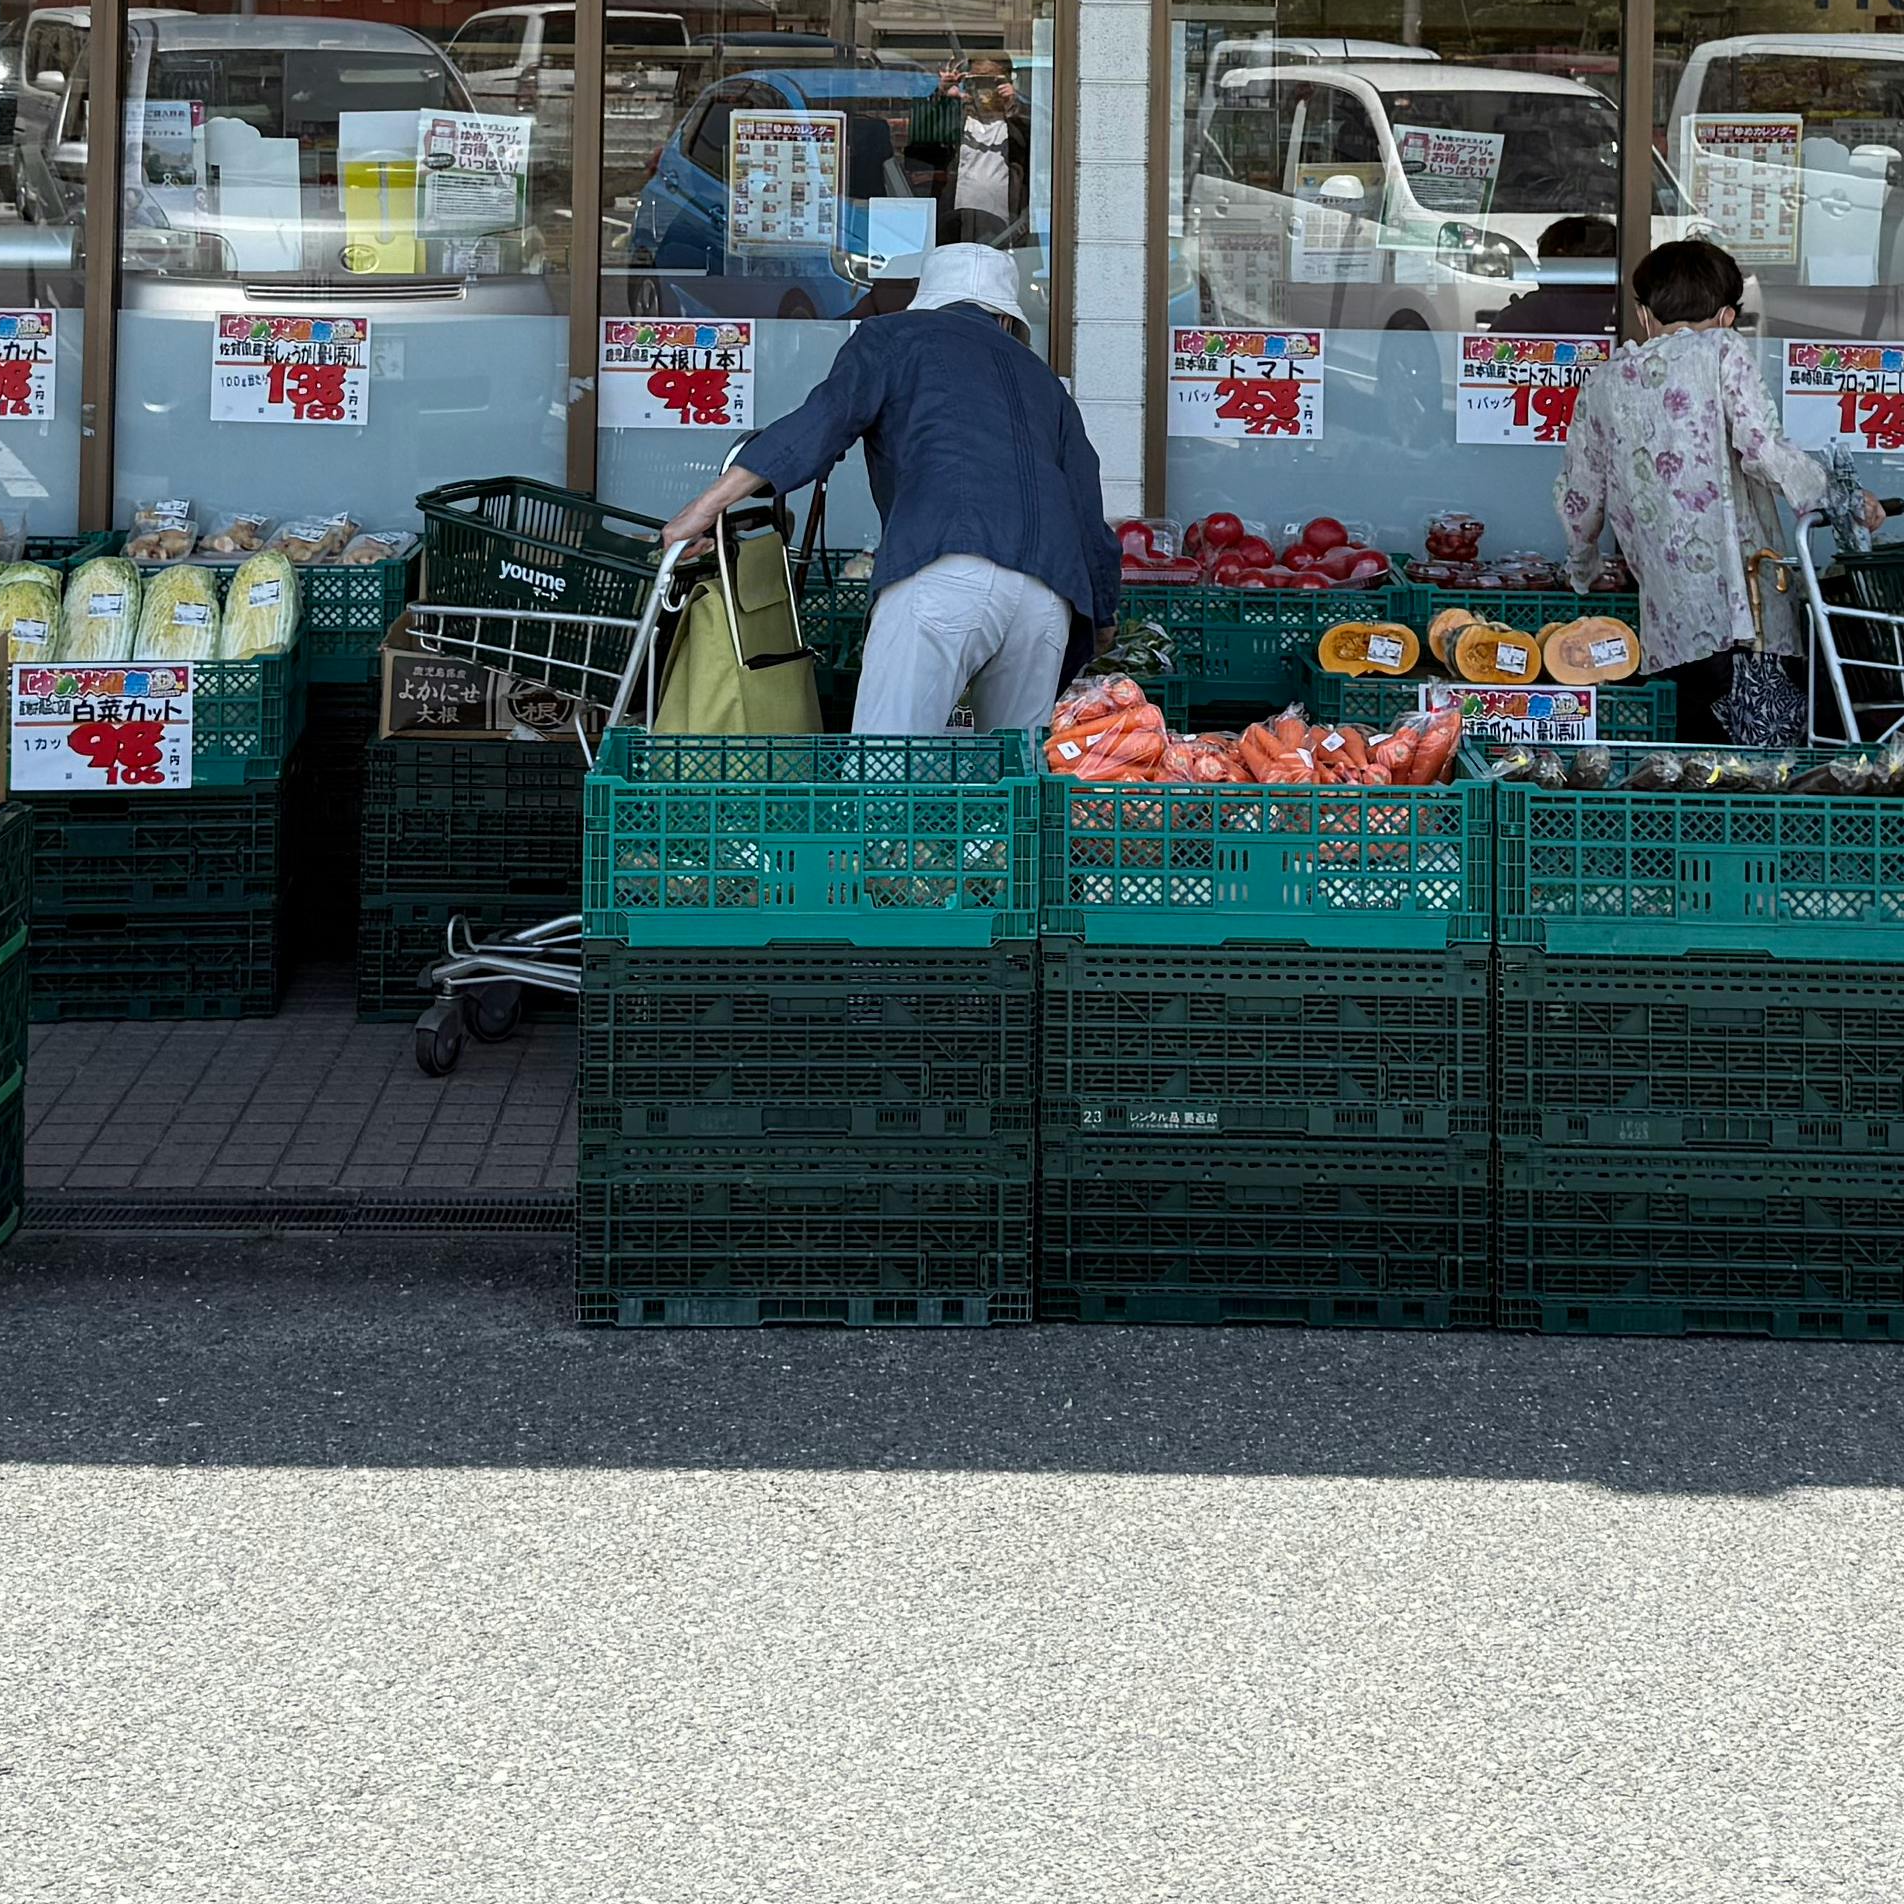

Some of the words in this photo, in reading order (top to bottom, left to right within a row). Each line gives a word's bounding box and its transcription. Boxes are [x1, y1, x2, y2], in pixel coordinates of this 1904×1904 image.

[1229, 359, 1305, 380] トマト
[266, 363, 346, 405] 138
[647, 369, 732, 410] 98
[1215, 379, 1302, 420] 258
[679, 408, 731, 424] 106
[1244, 418, 1301, 435] 279
[499, 558, 567, 593] youme
[398, 678, 481, 704] よかにせ
[72, 699, 183, 722] 白菜カット
[416, 705, 461, 725] 大根
[66, 721, 166, 768] 98
[105, 766, 166, 785] 106
[1083, 1110, 1102, 1123] 23
